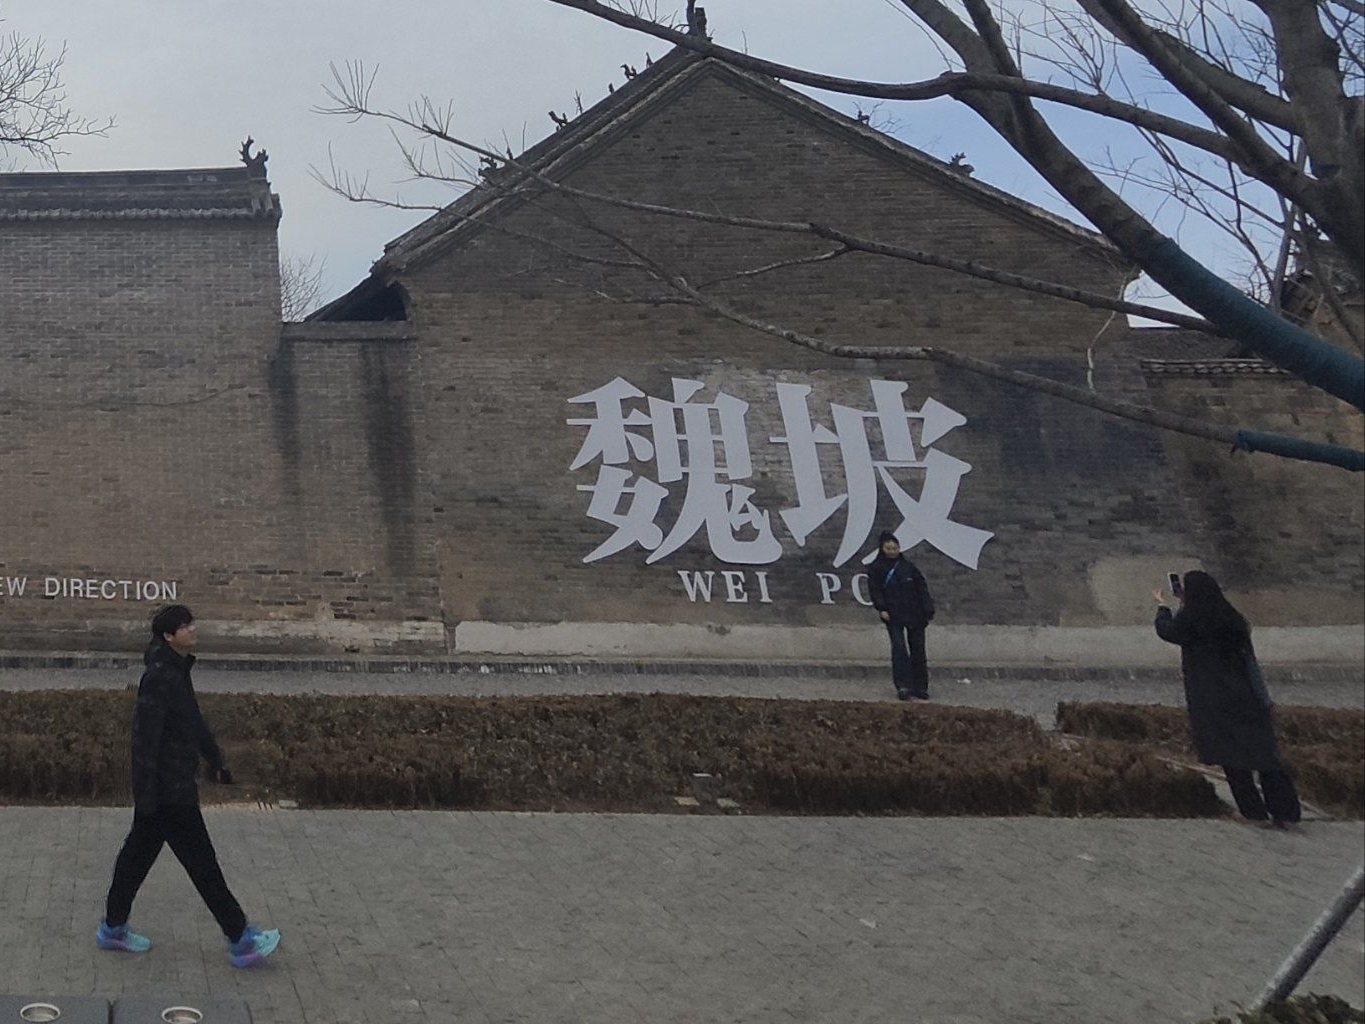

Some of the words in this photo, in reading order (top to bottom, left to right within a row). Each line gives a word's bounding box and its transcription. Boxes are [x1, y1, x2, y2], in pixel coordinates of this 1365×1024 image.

[566, 376, 995, 571] 魏坡
[45, 577, 177, 601] DIRECTION
[677, 570, 773, 603] WEI
